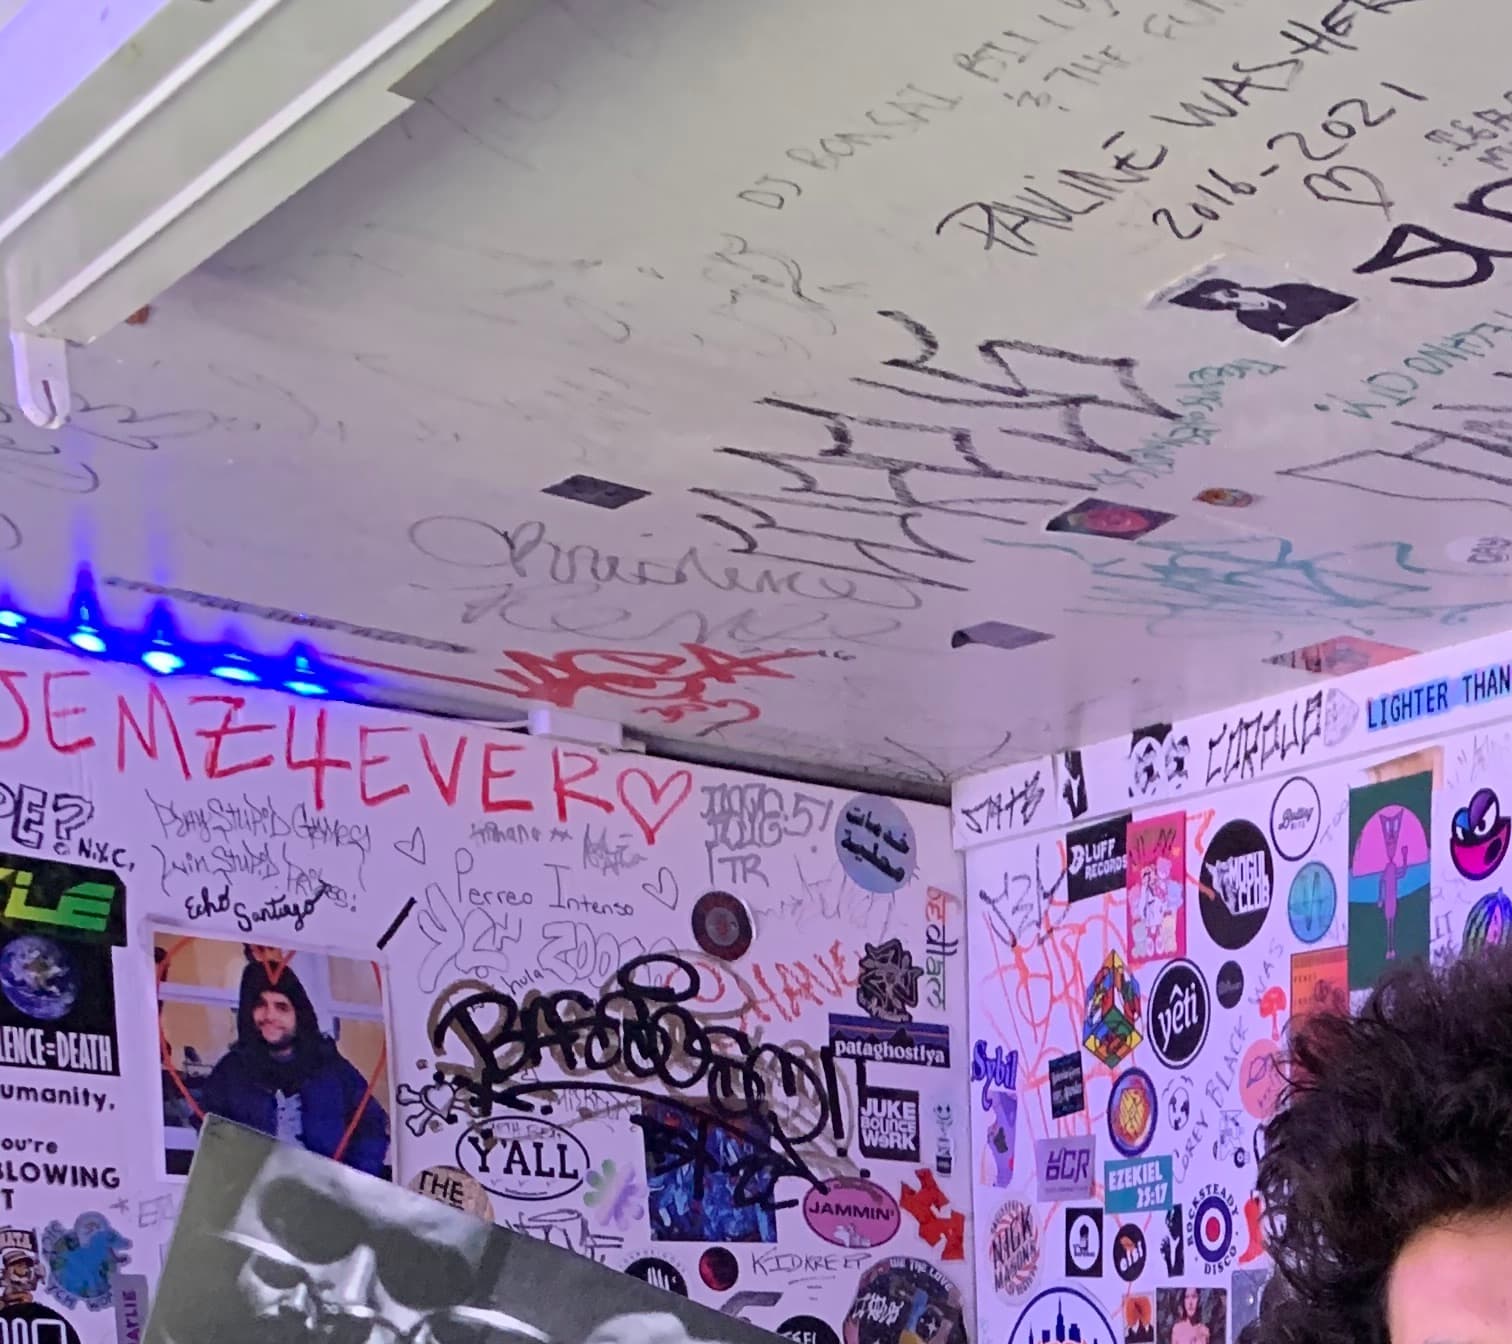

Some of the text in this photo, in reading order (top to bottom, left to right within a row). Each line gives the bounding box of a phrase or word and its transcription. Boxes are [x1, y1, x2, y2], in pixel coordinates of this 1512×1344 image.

[937, 57, 1303, 256] PAULINE WAS
[1367, 687, 1449, 729] LIGHTER
[1462, 666, 1511, 705] THAN
[1068, 835, 1119, 875] BLUFF
[1084, 854, 1128, 881] RECORDS
[543, 862, 635, 917] Intenso
[1156, 980, 1200, 1052] yêti
[971, 1038, 1019, 1110] Sybil
[860, 1115, 917, 1136] BOUNCE
[861, 1098, 917, 1120] JUKE
[466, 1135, 580, 1184] Y'ALL
[1109, 1160, 1164, 1193] EZEKIEL
[807, 1200, 897, 1223] JAMMIN'
[1186, 1183, 1240, 1247] ROCKSTEADY
[1203, 1244, 1238, 1276] DISCO
